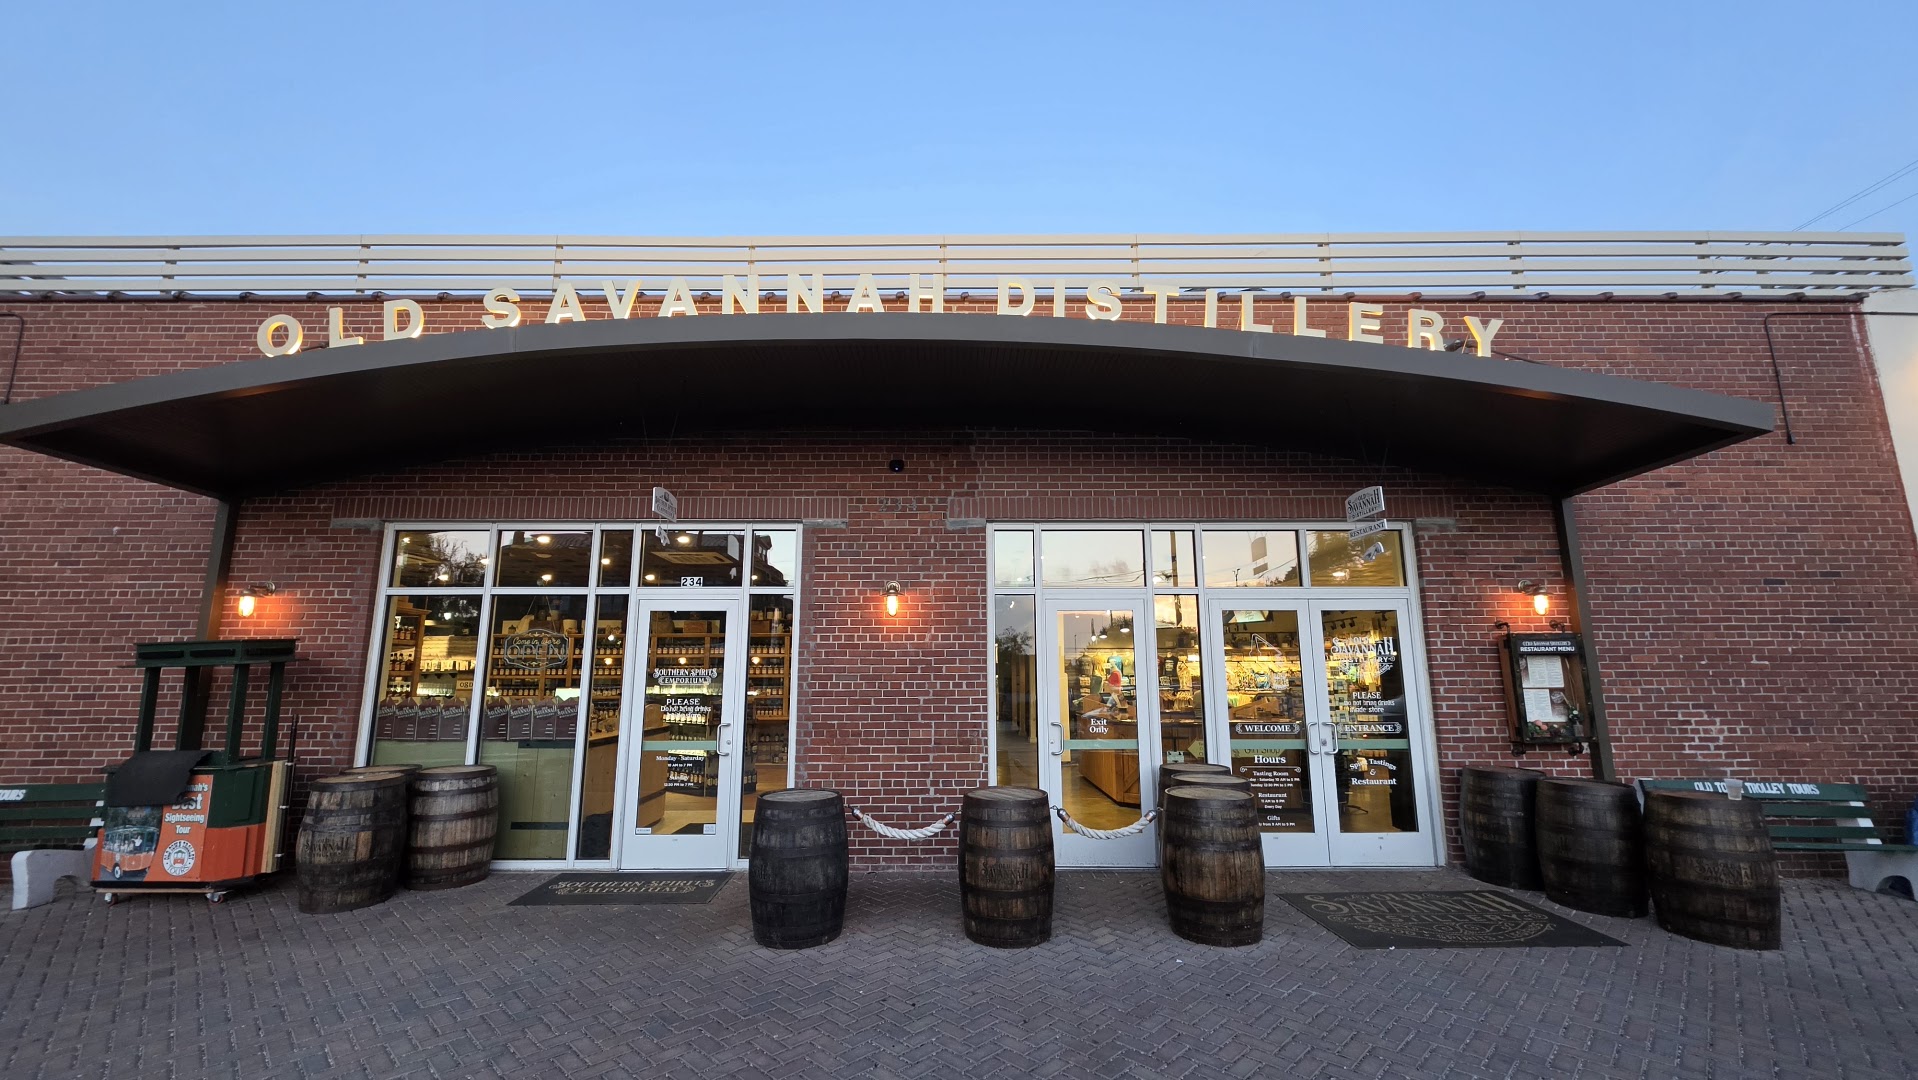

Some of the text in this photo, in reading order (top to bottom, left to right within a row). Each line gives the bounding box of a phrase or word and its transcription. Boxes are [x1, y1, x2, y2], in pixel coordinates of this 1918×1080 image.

[257, 274, 1504, 357] OLD SAVANNAH DISTILLERY
[878, 497, 917, 512] 234
[1347, 489, 1380, 514] SAVANNAH
[1350, 522, 1384, 538] RESTAURANT
[682, 577, 702, 587] 234
[507, 644, 565, 659] OPEN
[1331, 637, 1394, 655] SAVANNAH
[653, 668, 717, 678] SOUTHERN SPIRITS
[1091, 718, 1107, 726] Exit
[1089, 726, 1109, 734] Only
[1254, 755, 1286, 764] Hours
[1369, 759, 1397, 771] Tastings
[1694, 782, 1713, 792] OLD
[1744, 783, 1785, 794] TROLLEY
[1786, 783, 1820, 795] TOURS
[164, 812, 204, 824] Sightseeing
[176, 825, 191, 834] Tour
[549, 880, 716, 889] SOUTHERN SPIRITS
[1304, 892, 1531, 914] SAVANNAH
[1352, 914, 1522, 922] DISTILLERY
